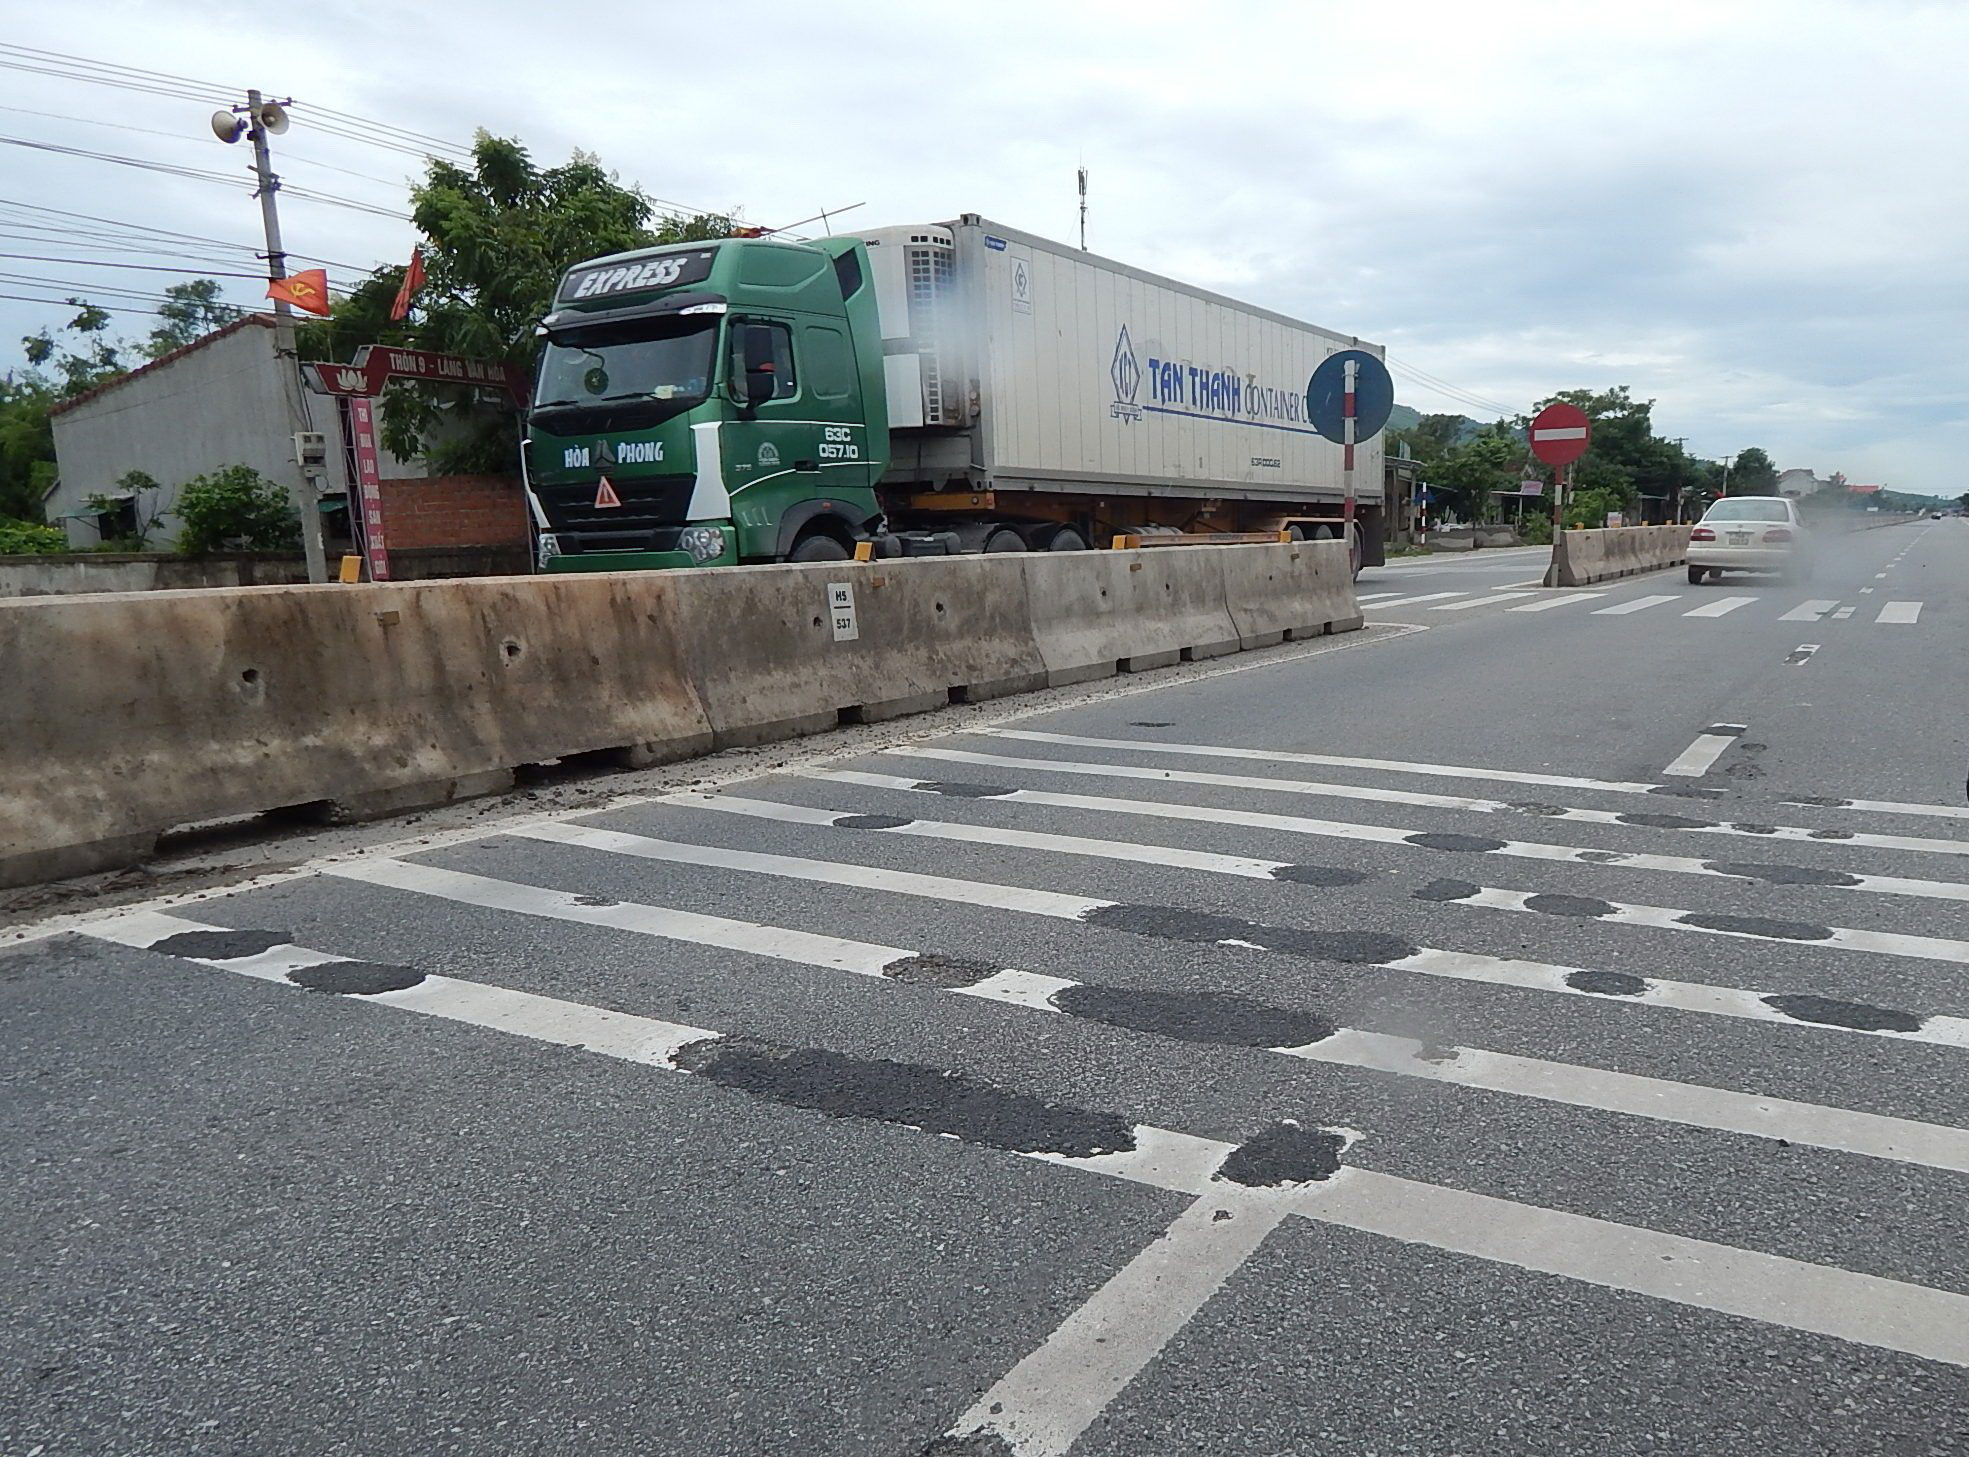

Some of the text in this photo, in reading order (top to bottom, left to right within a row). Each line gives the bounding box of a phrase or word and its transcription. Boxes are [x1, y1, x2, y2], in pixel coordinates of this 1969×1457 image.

[864, 239, 881, 247] ING
[573, 257, 688, 298] EXPRESS
[389, 352, 418, 372] THÔN
[418, 356, 426, 374] 9
[1188, 367, 1241, 417] THANH
[1244, 383, 1300, 423] CONTAINER
[1301, 395, 1314, 425] C
[824, 427, 851, 442] 63C
[564, 441, 664, 468] HÒA PHONG
[818, 443, 859, 459] 057.10
[836, 618, 851, 630] 537
